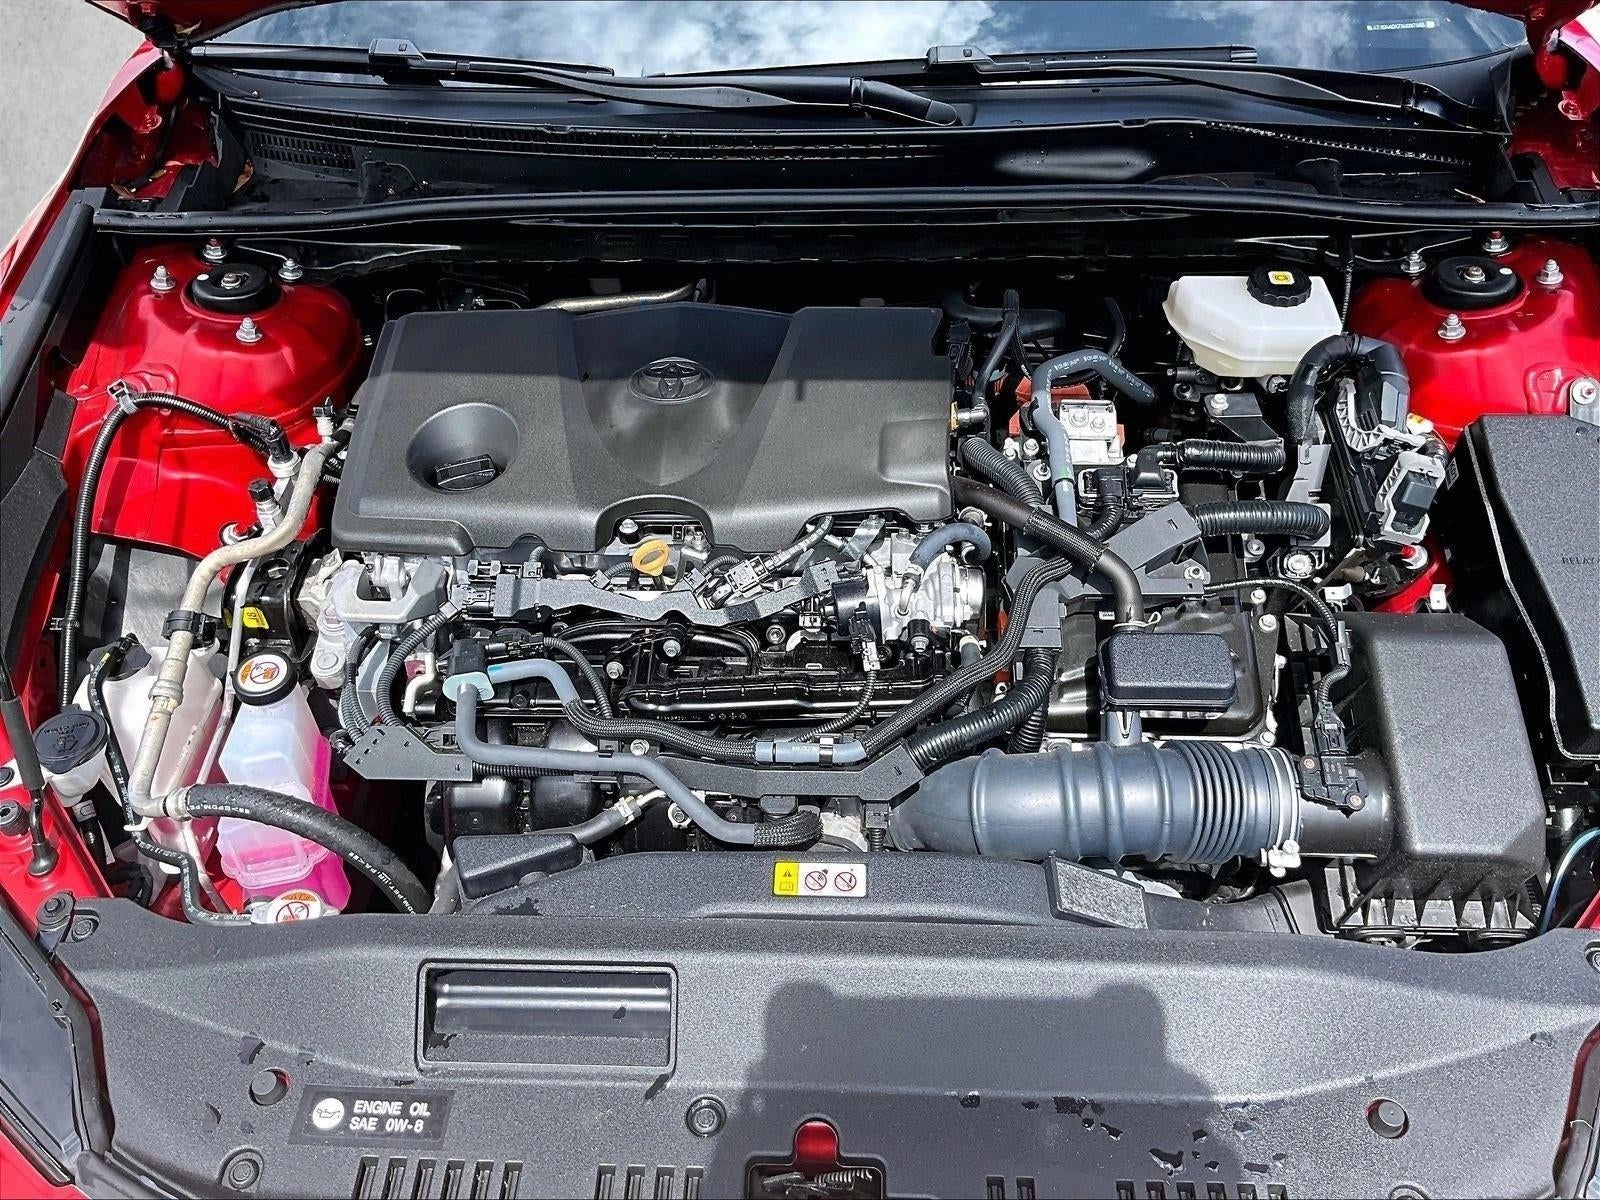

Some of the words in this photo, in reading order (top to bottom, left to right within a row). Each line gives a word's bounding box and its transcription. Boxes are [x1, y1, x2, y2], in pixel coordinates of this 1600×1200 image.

[353, 1100, 403, 1115] ENGINE
[409, 1102, 431, 1116] OIL
[349, 1116, 379, 1131] SAE
[385, 1118, 424, 1133] 0W-8
